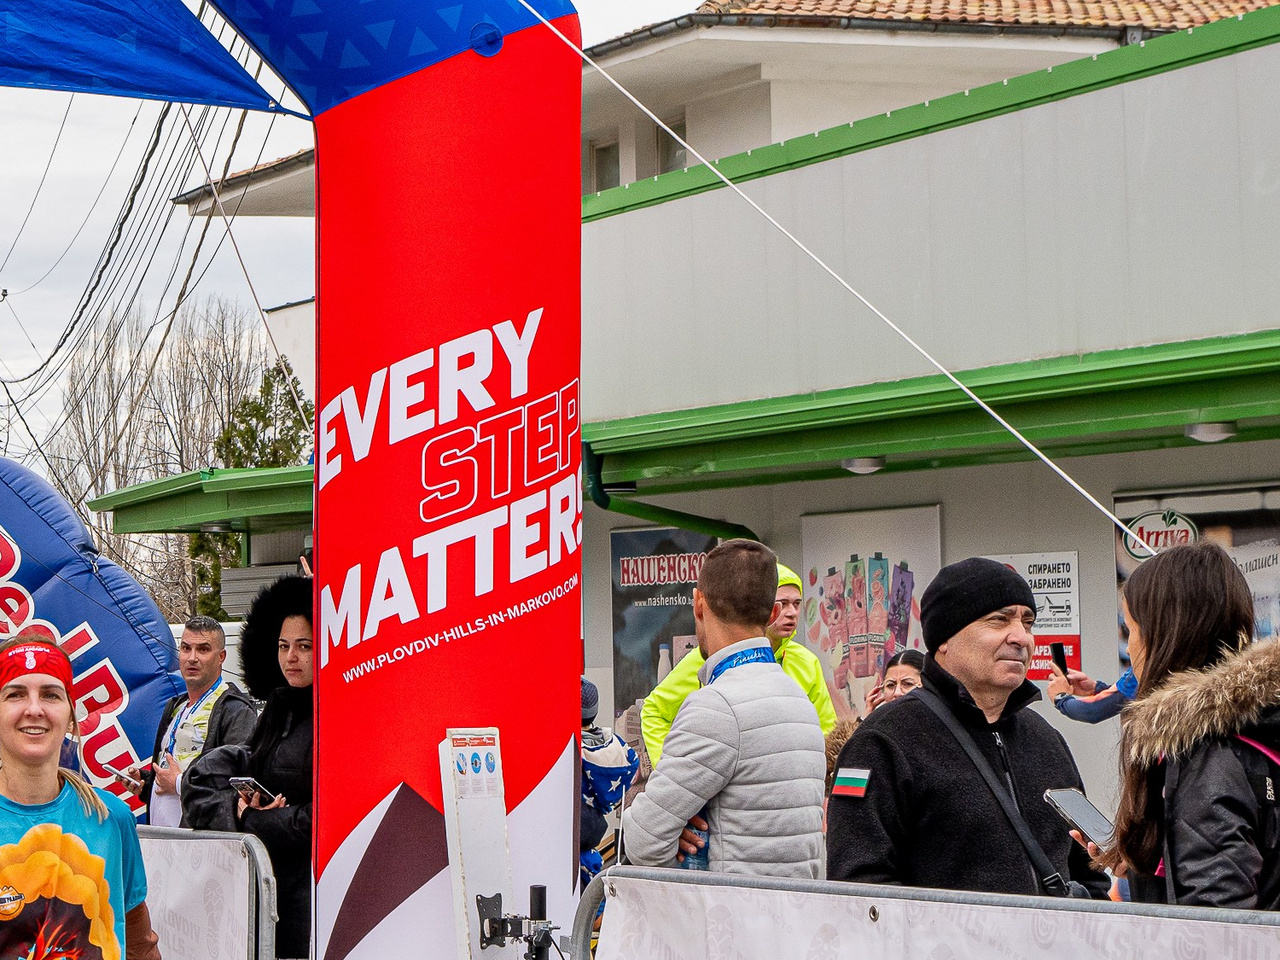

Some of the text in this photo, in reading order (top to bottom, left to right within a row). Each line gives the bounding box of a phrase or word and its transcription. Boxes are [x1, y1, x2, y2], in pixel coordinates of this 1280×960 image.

[319, 307, 544, 491] EVERY
[420, 377, 580, 523] STEP
[1027, 563, 1071, 575] СПИРАНЕТО
[1131, 526, 1190, 550] Arriva
[1028, 577, 1072, 590] ЗАБРАНЕНО
[342, 572, 579, 684] WWW.PLOVDIV-HILLS-IN-MARKOVO.COM
